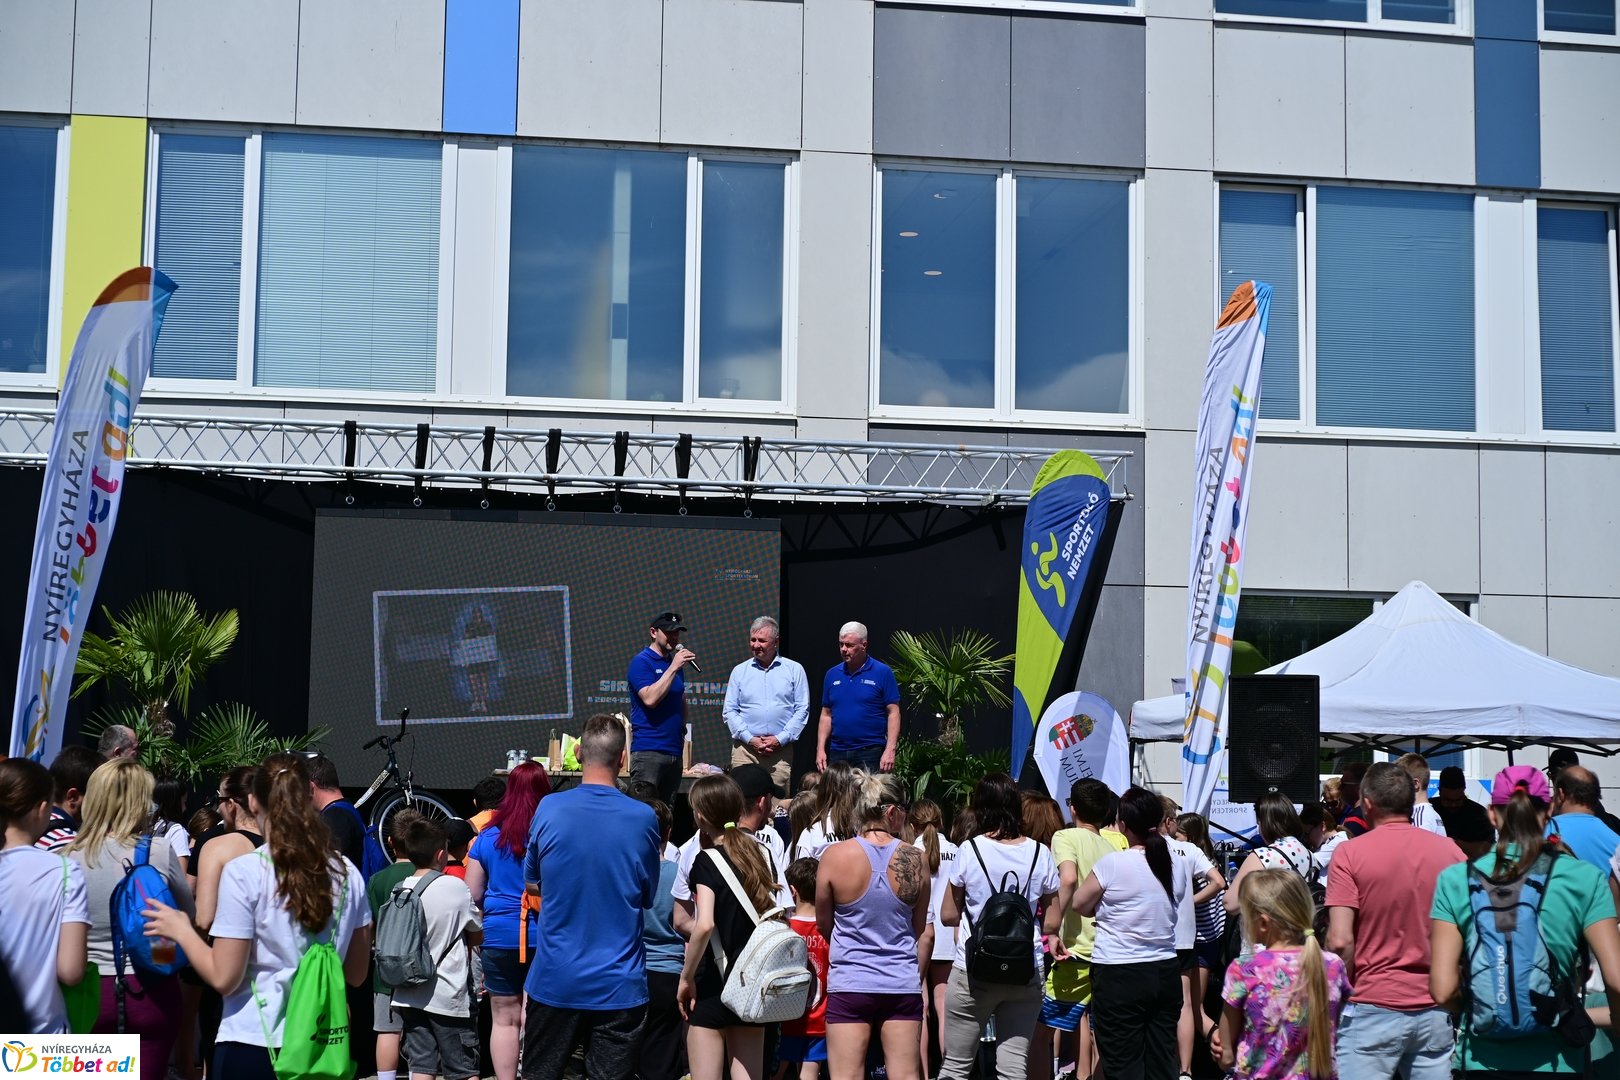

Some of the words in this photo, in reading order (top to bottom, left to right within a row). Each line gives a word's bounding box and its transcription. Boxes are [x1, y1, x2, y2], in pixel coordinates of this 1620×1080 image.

[43, 430, 89, 643] NYÍREGYHÁZA
[1067, 523, 1094, 580] NEMZET
[600, 680, 630, 692] SIR
[1497, 945, 1508, 1005] Quechua
